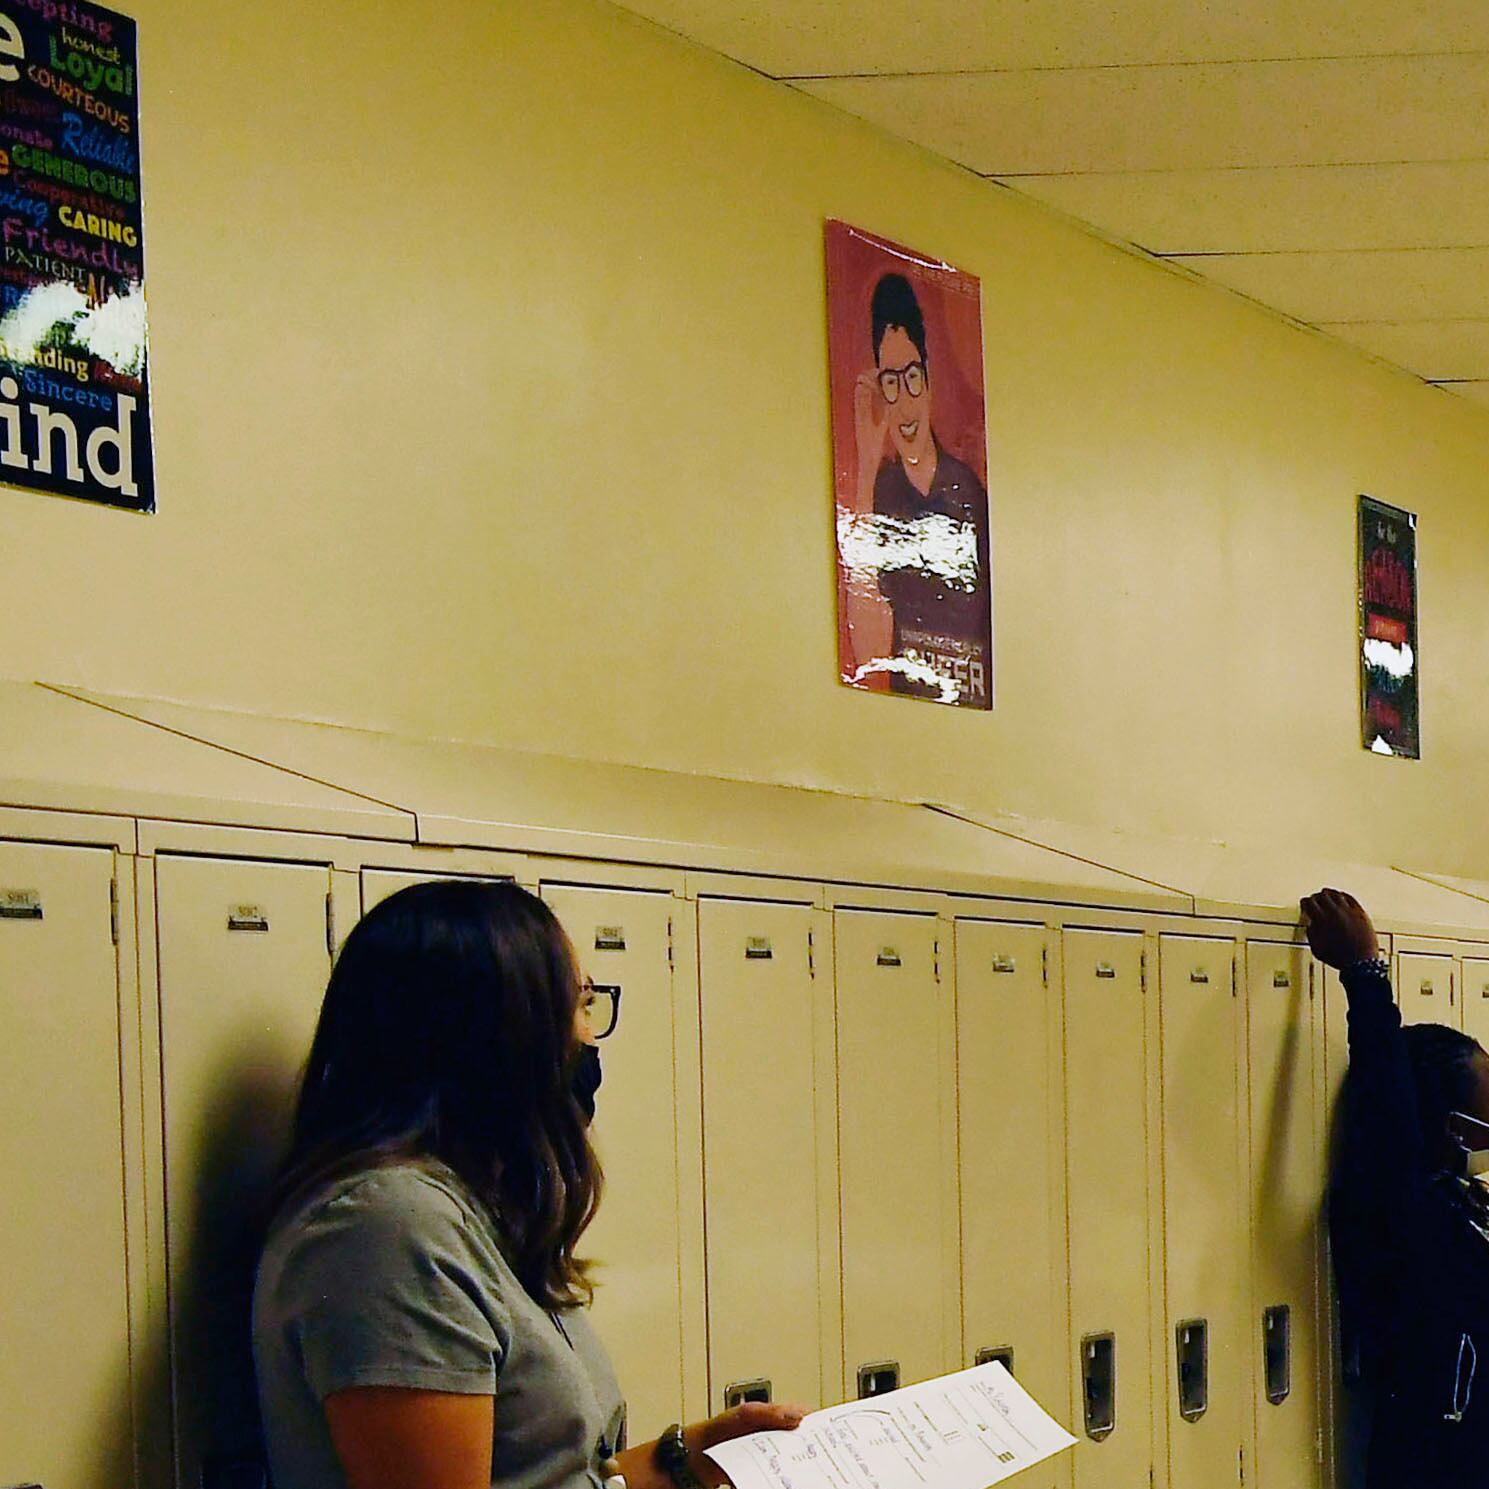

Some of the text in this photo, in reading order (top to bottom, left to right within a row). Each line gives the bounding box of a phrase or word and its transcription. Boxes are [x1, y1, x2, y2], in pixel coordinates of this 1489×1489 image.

[48, 33, 135, 96] Loyal
[61, 25, 121, 65] honest
[26, 64, 131, 134] COURTEOUS
[12, 143, 137, 203] GENEROUS
[3, 216, 139, 280] Friendly
[58, 204, 138, 248] CARING
[5, 245, 87, 281] PATIENT
[23, 367, 114, 412] Sincere
